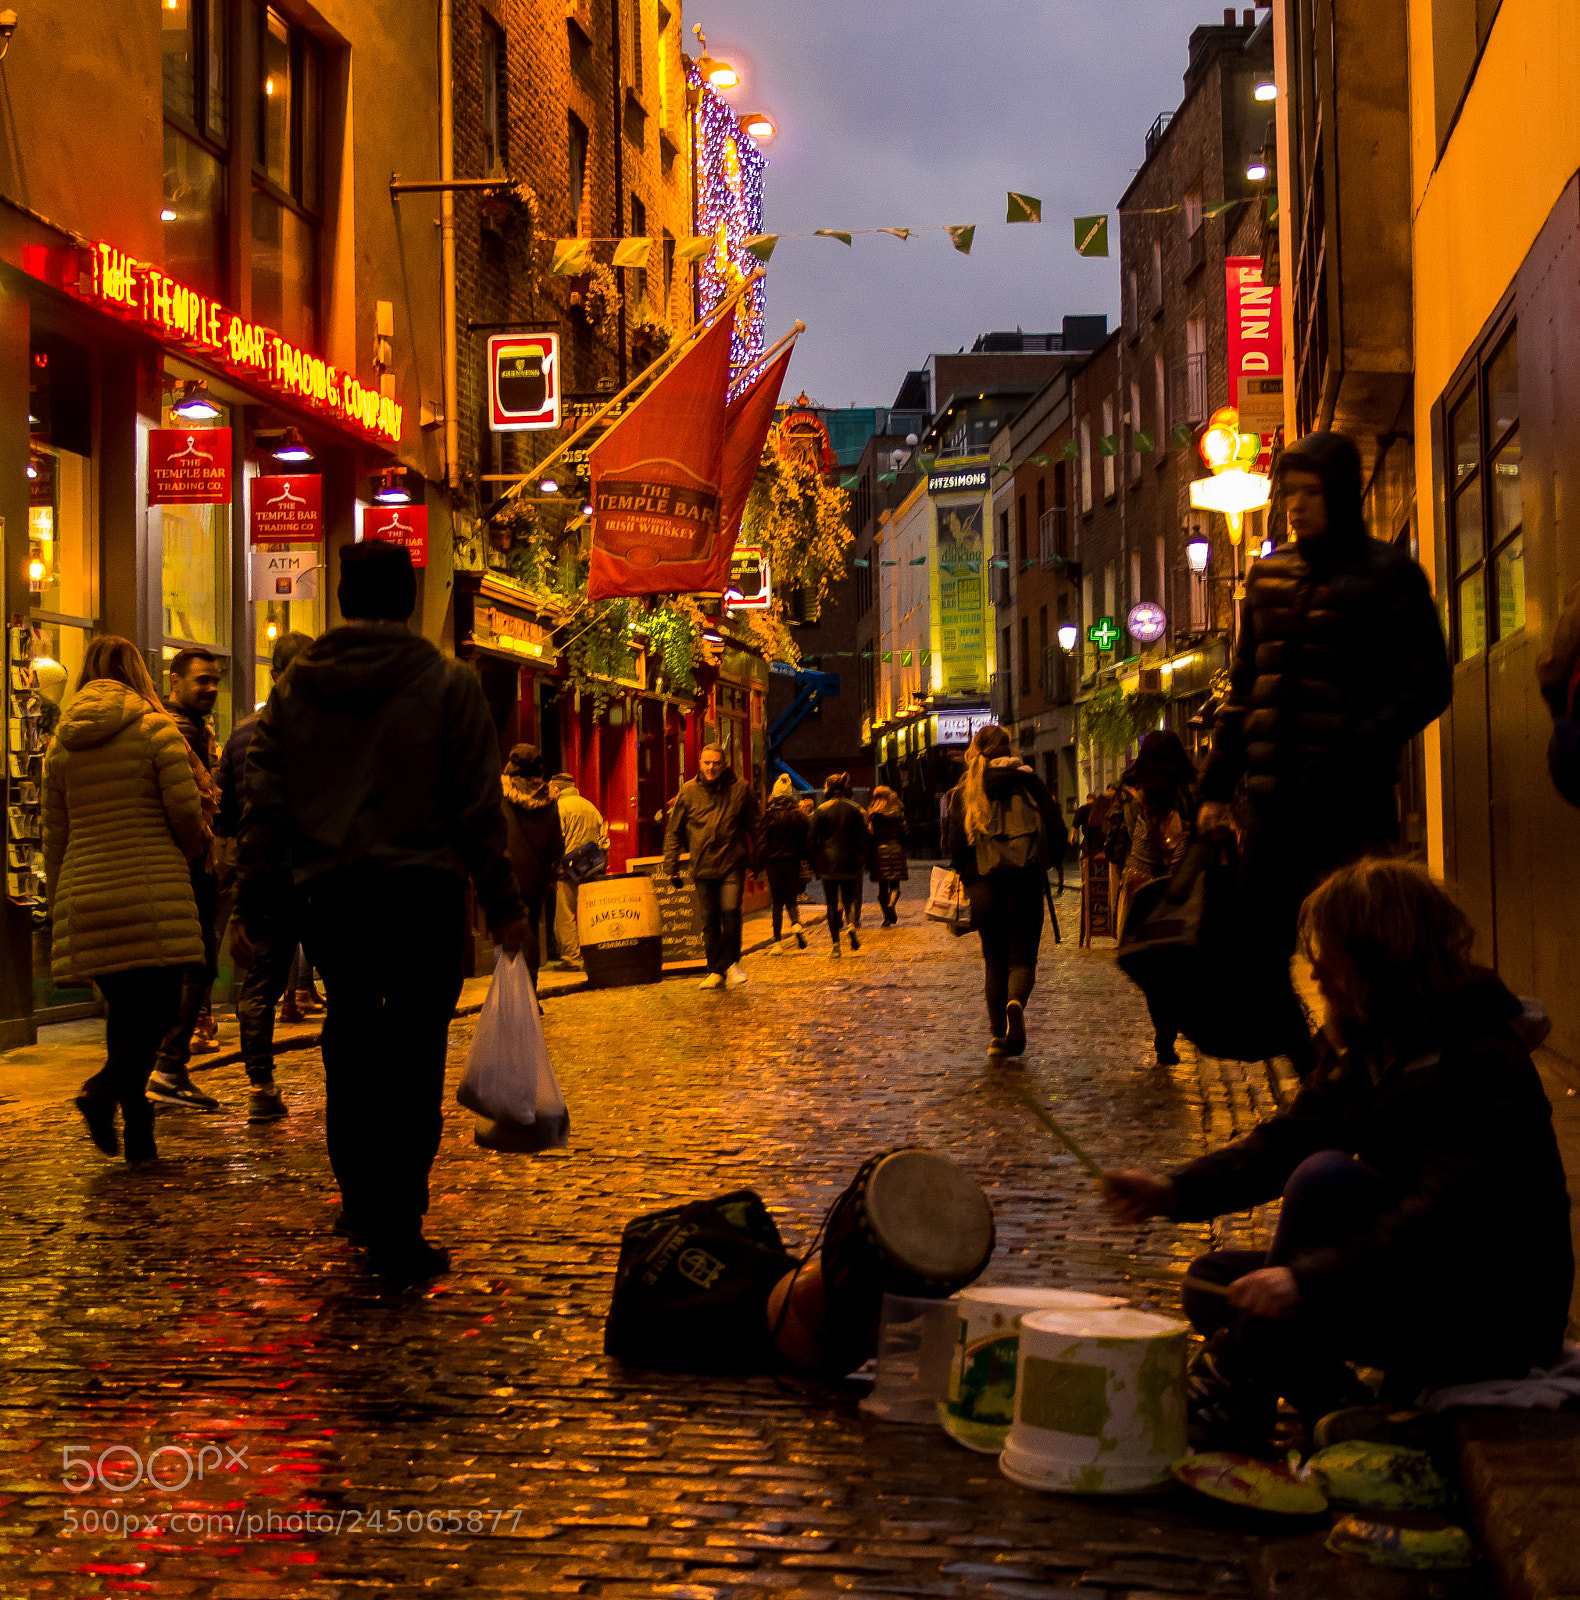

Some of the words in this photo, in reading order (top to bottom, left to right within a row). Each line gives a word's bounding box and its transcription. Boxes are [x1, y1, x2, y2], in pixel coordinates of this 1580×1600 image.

[98, 242, 138, 307] THE
[149, 270, 223, 348] TEMPLE
[228, 316, 266, 369] BAR
[272, 337, 338, 407] TRADING
[343, 374, 402, 442] COMPANY
[500, 368, 541, 379] GUINNESS
[180, 458, 201, 467] THE
[154, 468, 201, 480] TEMPLE
[202, 467, 226, 479] BAR
[157, 481, 205, 491] TRADING
[206, 481, 223, 491] CO.
[929, 472, 987, 490] FITZSIMONS
[640, 483, 671, 499] THE
[278, 502, 296, 511] THE
[598, 494, 669, 514] TEMPLE
[673, 501, 714, 523] BAR
[255, 511, 296, 521] TEMPLE
[297, 510, 318, 520] BAR
[258, 523, 300, 532] TRADING
[605, 519, 636, 533] IRISH
[638, 522, 697, 540] WHISKEY
[387, 530, 404, 538] THE
[405, 537, 424, 547] BAR
[268, 557, 301, 570] ATM
[590, 908, 641, 928] JAMESON
